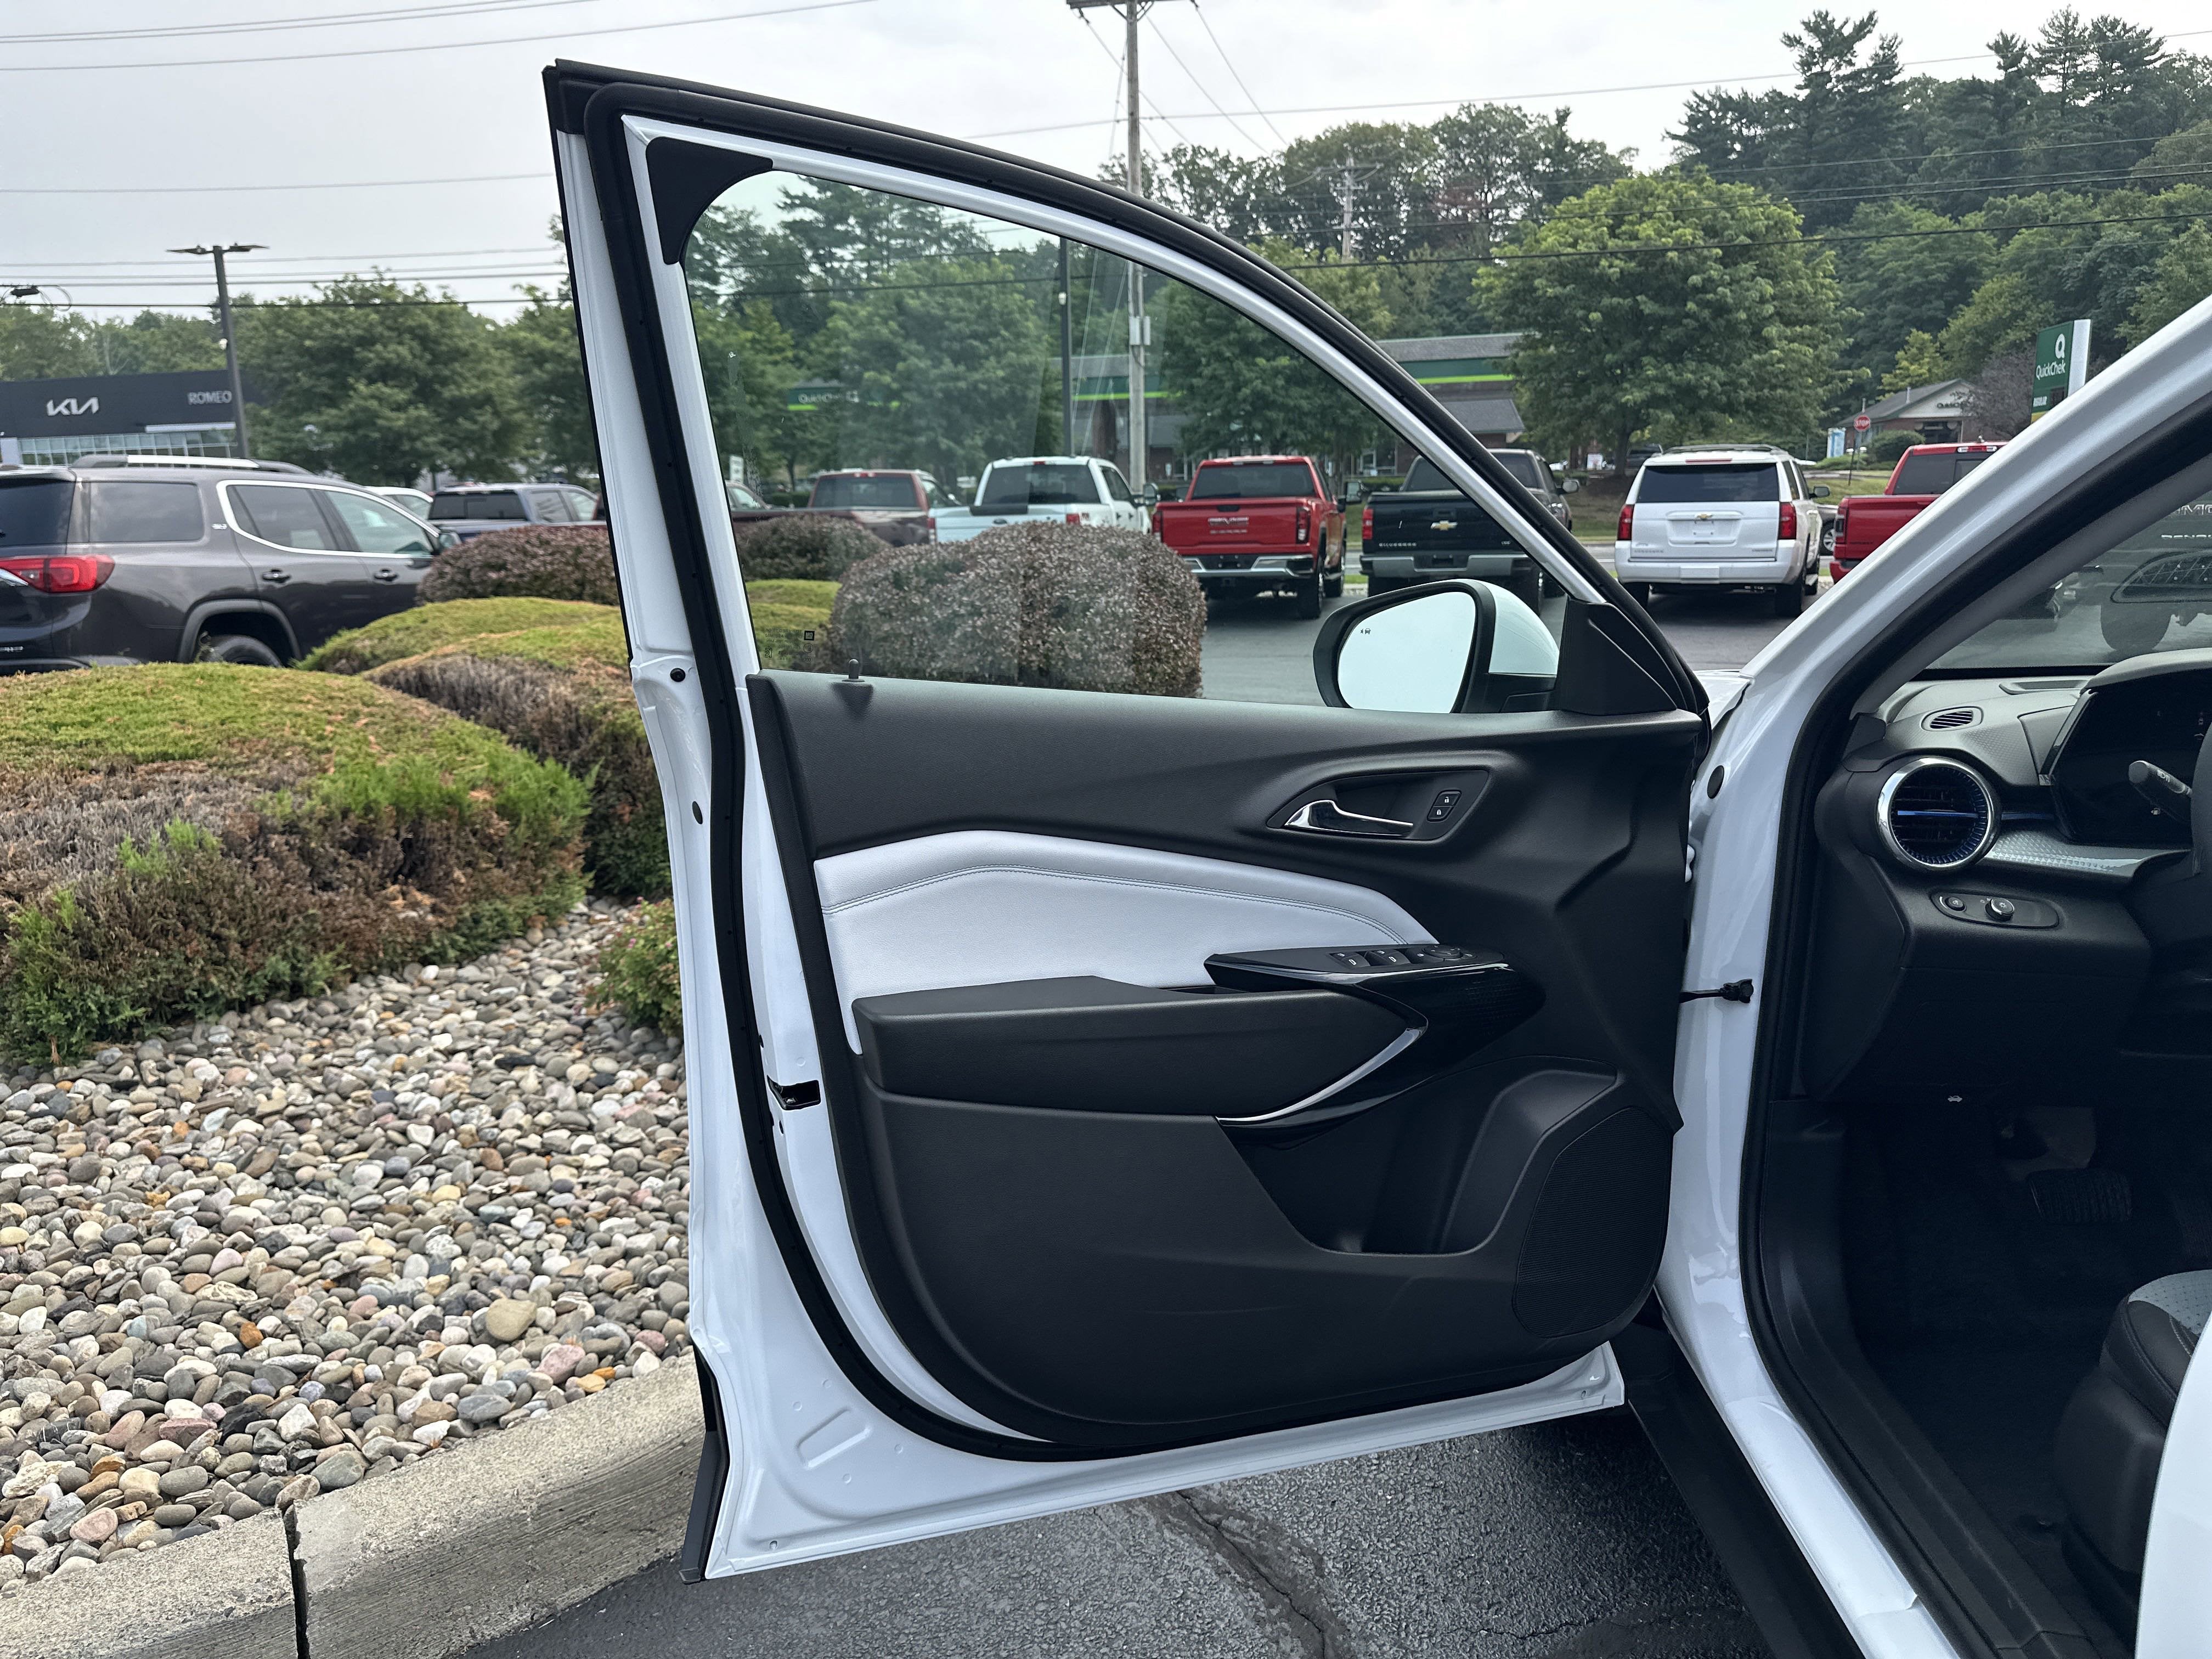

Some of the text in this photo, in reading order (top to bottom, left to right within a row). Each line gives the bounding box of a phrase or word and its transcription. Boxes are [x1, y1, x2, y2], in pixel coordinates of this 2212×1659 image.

[2036, 359, 2066, 380] QuickChek
[187, 390, 232, 405] ROMEO
[1855, 419, 1870, 427] STOP
